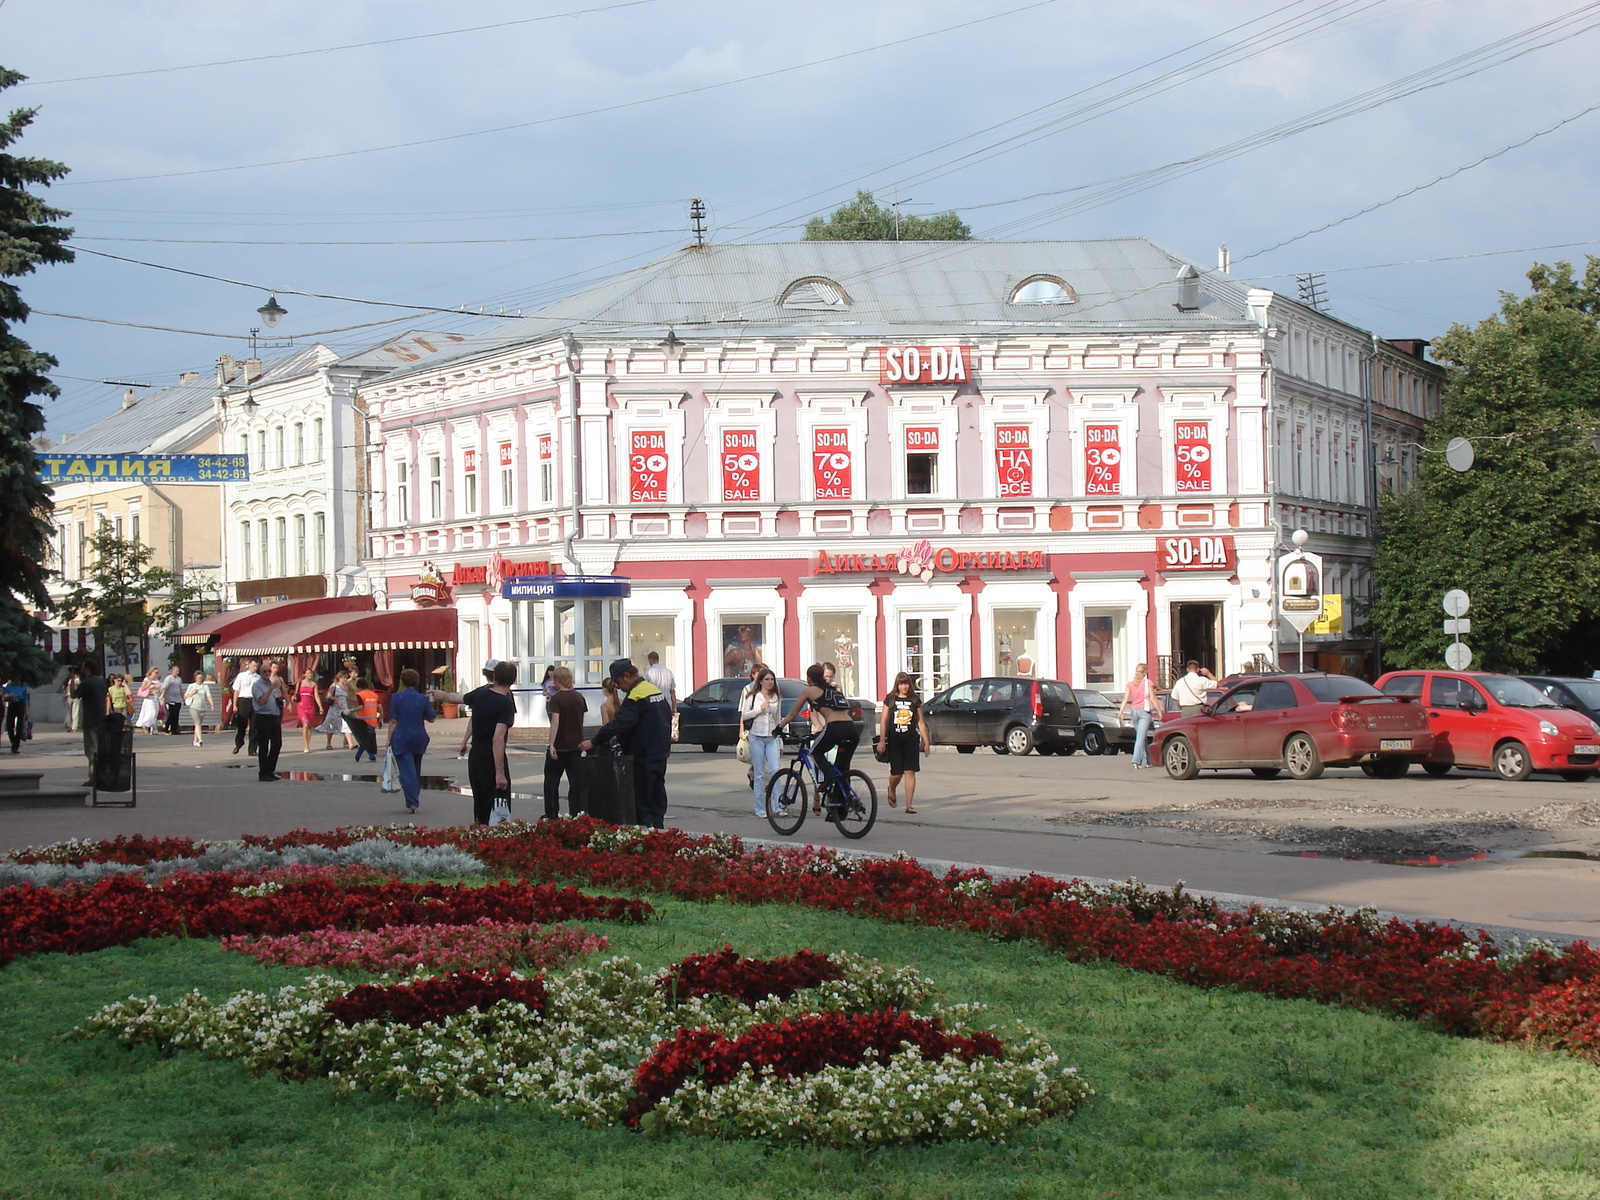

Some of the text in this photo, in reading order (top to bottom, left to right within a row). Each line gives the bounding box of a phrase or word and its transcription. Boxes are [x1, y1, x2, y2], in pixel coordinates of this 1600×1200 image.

[198, 458, 245, 467] 34-42-68
[1000, 450, 1031, 467] НА
[35, 459, 171, 476] ТАЛИЯ
[1184, 463, 1202, 478] %
[198, 469, 246, 479] 34-42-69
[823, 471, 842, 485] %
[1095, 466, 1112, 481] %
[640, 473, 658, 488] %
[731, 472, 750, 487] %
[1177, 480, 1210, 490] SALE
[816, 488, 850, 498] SALE
[1000, 481, 1031, 494] ВСЁ
[1088, 483, 1120, 493] SALE
[632, 490, 667, 500] SALE
[724, 489, 759, 499] SALE
[511, 585, 554, 595] МИЛИЦИЯ
